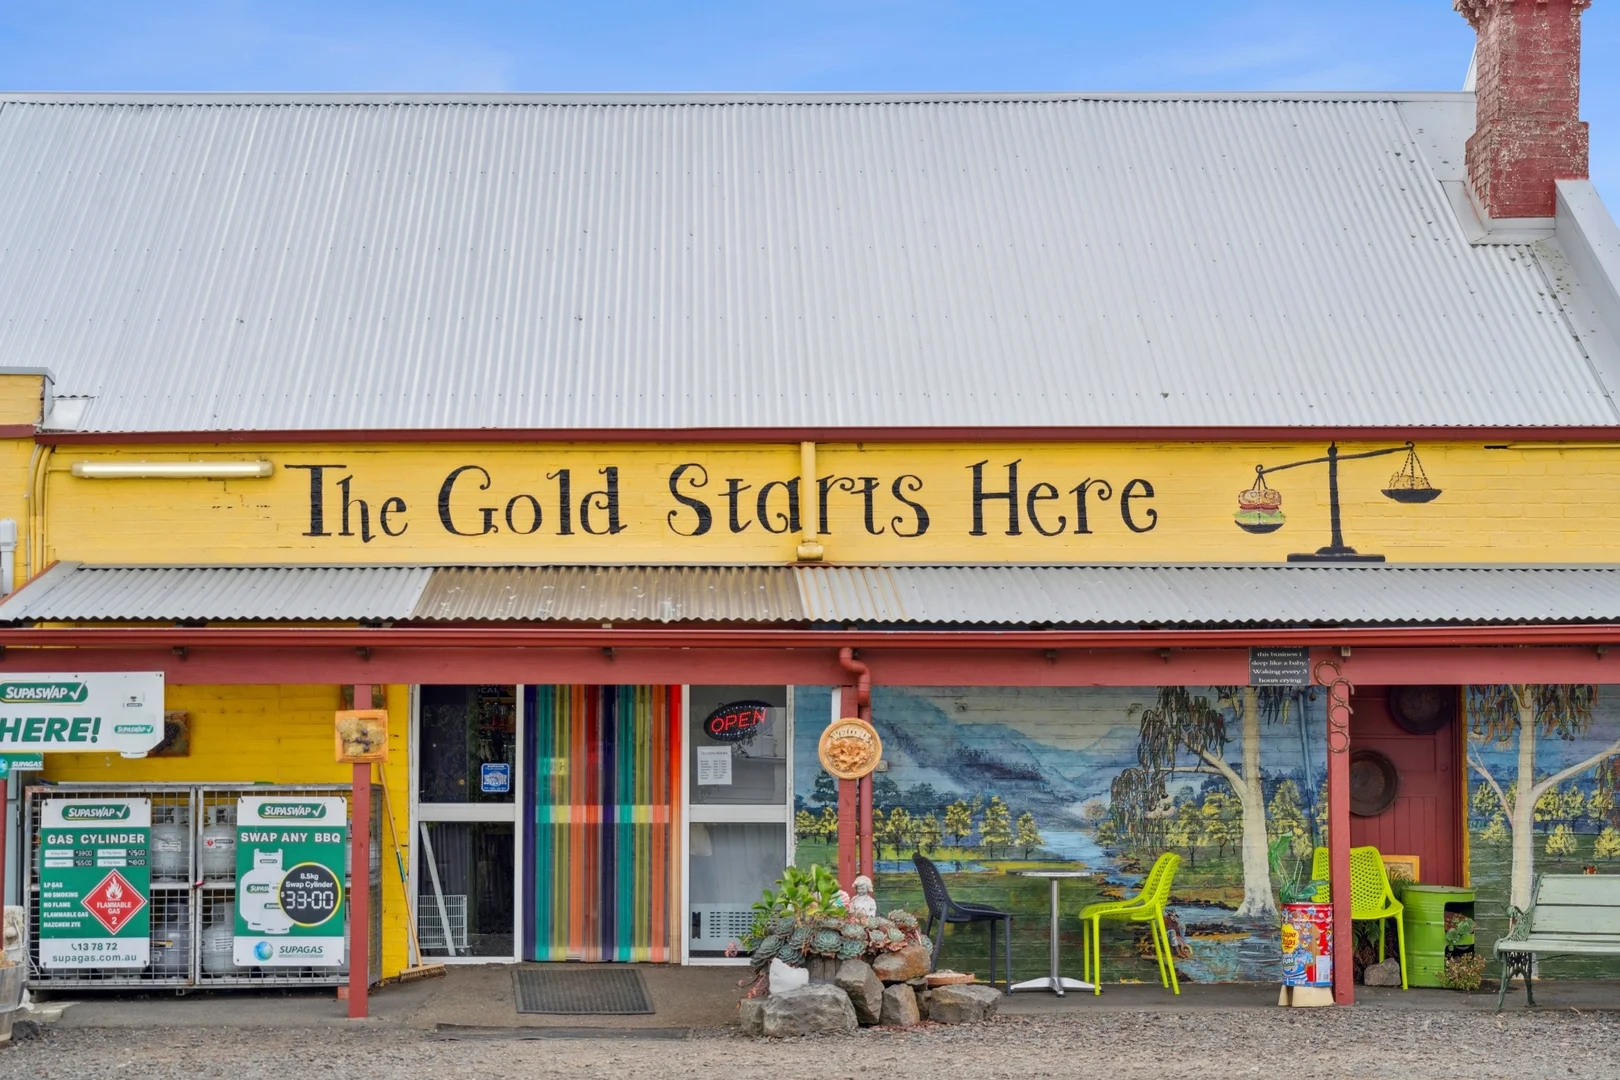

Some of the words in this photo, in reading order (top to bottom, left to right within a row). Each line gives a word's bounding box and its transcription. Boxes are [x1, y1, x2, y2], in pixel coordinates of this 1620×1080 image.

[284, 463, 409, 543] The
[438, 464, 628, 536] Gold
[667, 462, 930, 537] Starts
[964, 457, 1158, 537] Here
[5, 685, 68, 699] SUPASWAP
[711, 708, 767, 733] OPEN
[0, 717, 102, 743] HERE!
[11, 760, 43, 769] SUPAGAS
[68, 807, 115, 818] SUPASWAP
[264, 805, 312, 816] SUPASWAP
[47, 834, 74, 845] GAS
[80, 833, 146, 844] CYLINDER
[240, 832, 278, 842] SWAP
[281, 832, 308, 842] ANY
[314, 832, 341, 844] BBQ
[300, 872, 319, 881] 8.5kg
[285, 881, 305, 890] Swap
[305, 881, 334, 889] Cylinder
[111, 917, 118, 925] 2
[77, 943, 89, 951] 13
[92, 943, 103, 951] 78
[106, 943, 118, 951] 72
[279, 945, 324, 954] SUPAGAS
[52, 953, 137, 963] supagas.com.au
